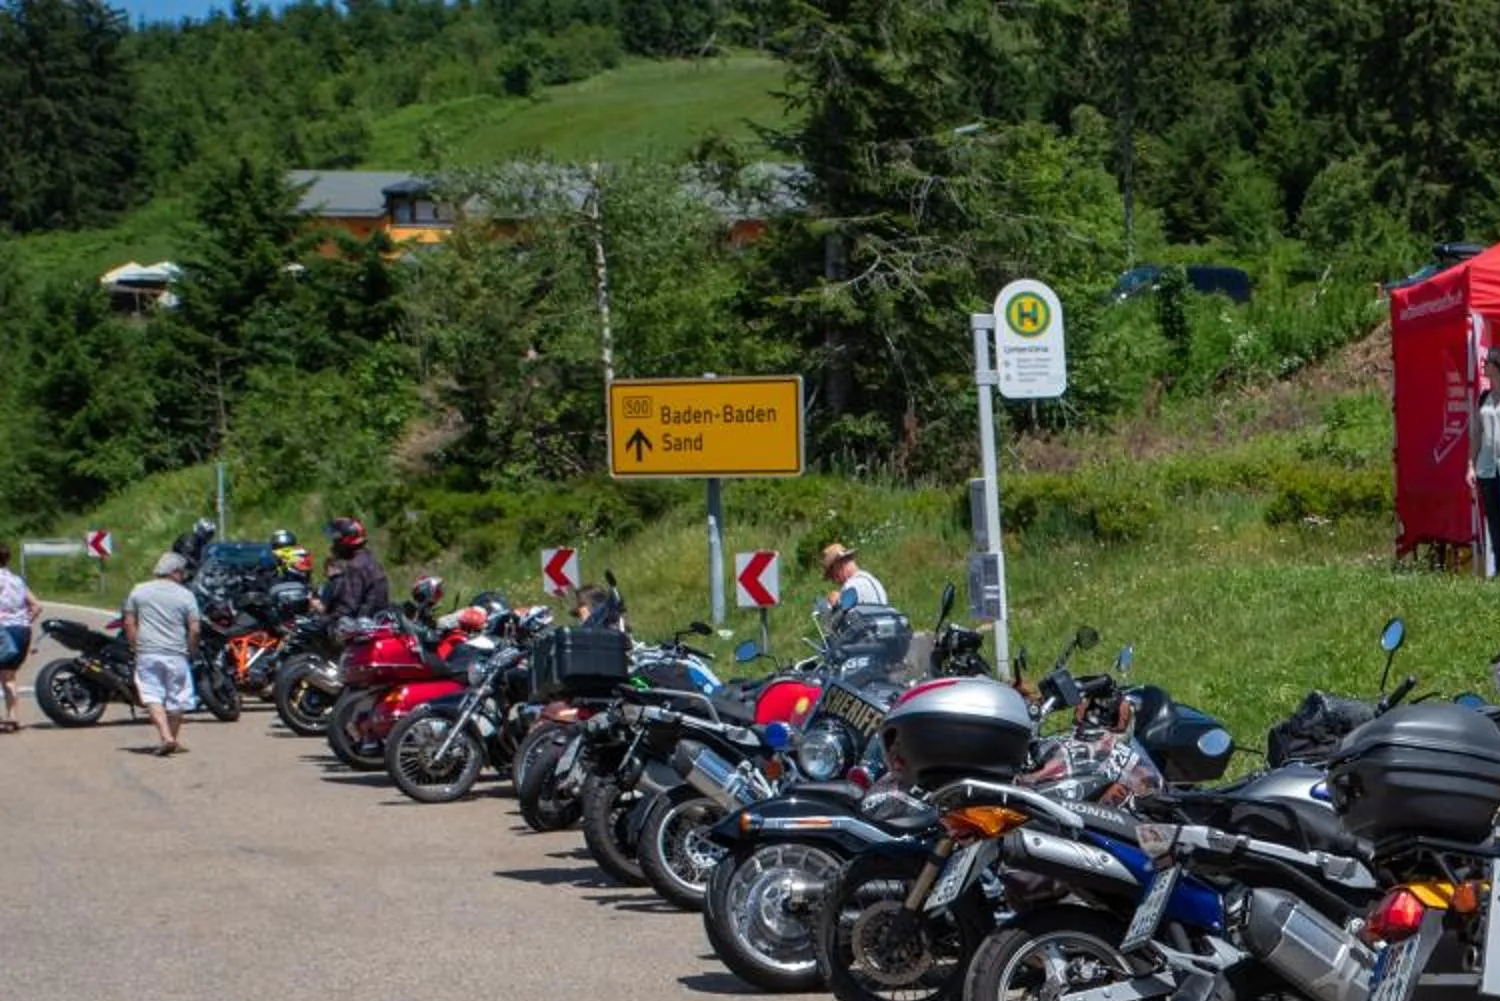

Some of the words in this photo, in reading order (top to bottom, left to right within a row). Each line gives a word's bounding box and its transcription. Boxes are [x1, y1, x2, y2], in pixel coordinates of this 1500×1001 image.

[660, 404, 777, 425] Baden-Baden
[662, 432, 703, 452] Sand
[827, 686, 884, 737] SHERIFF
[1061, 801, 1126, 825] HONDA
